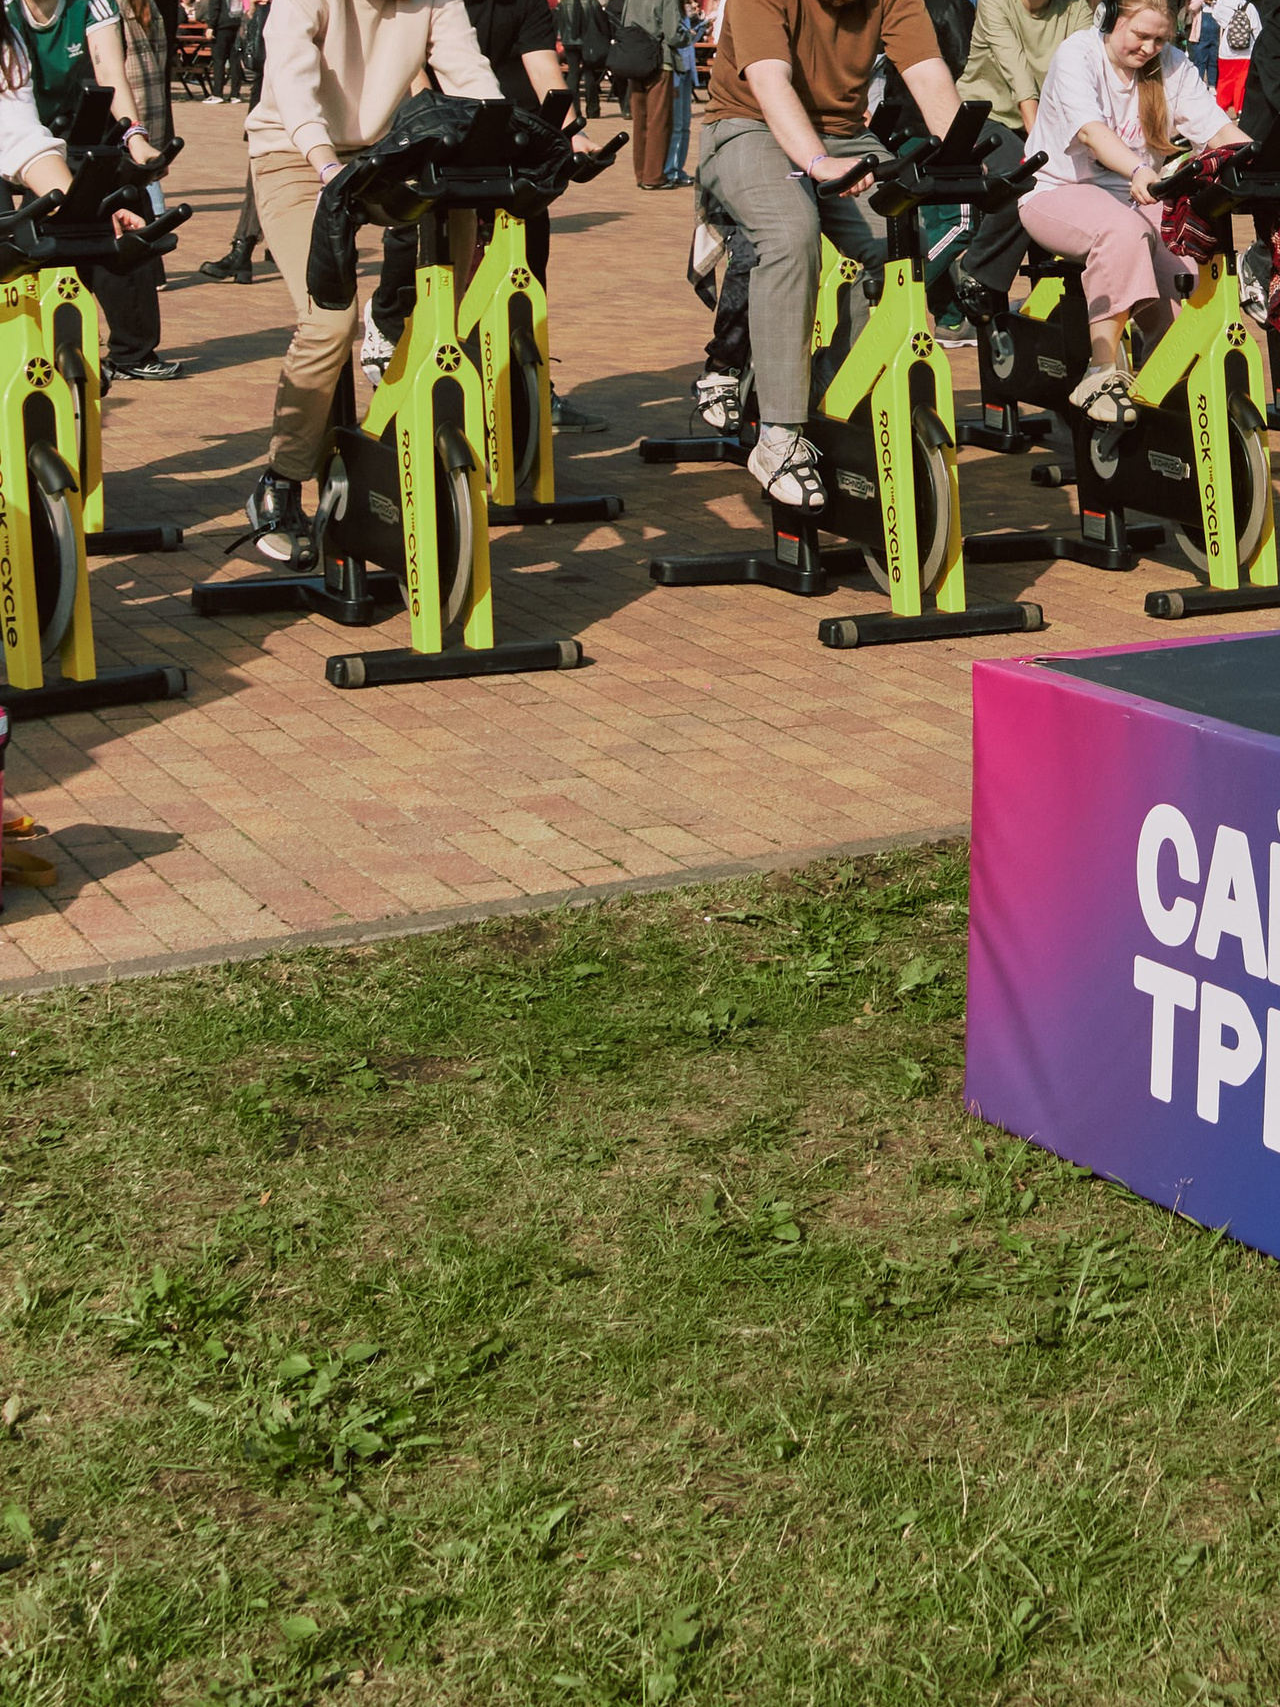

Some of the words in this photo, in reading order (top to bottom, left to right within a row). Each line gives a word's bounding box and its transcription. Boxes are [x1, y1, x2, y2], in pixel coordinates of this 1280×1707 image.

[425, 277, 431, 297] 7
[897, 268, 905, 287] 6
[1211, 262, 1219, 281] 8
[4, 286, 19, 308] 10
[485, 331, 494, 392] ROCK
[879, 409, 893, 484] ROCK
[1197, 394, 1212, 463] ROCK
[402, 429, 415, 508] ROCK
